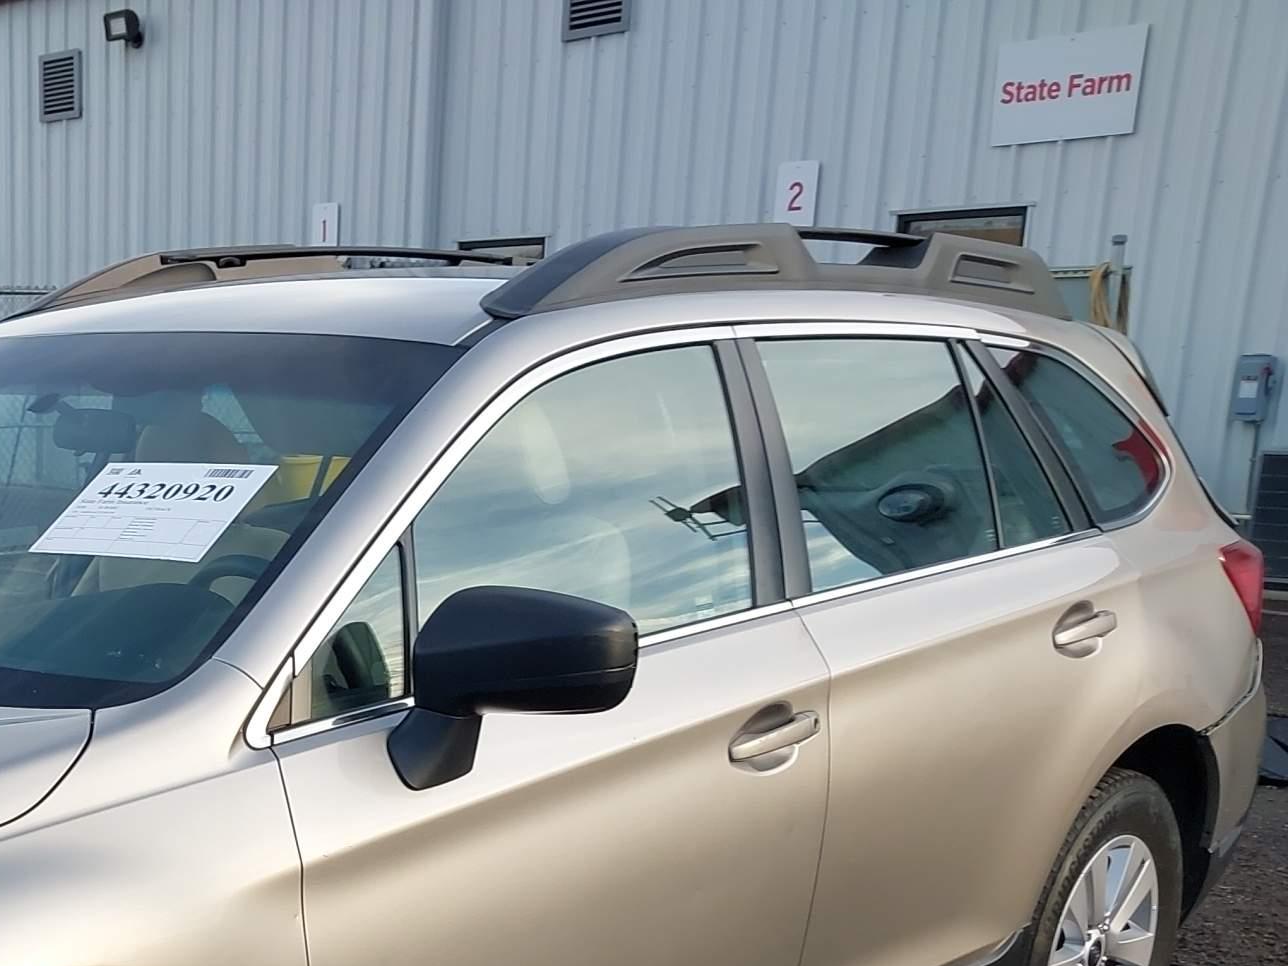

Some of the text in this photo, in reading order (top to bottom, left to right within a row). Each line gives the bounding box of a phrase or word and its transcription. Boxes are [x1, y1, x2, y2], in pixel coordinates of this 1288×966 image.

[1000, 73, 1132, 104] State Farm
[787, 182, 804, 211] 2
[97, 482, 235, 502] 44320920
